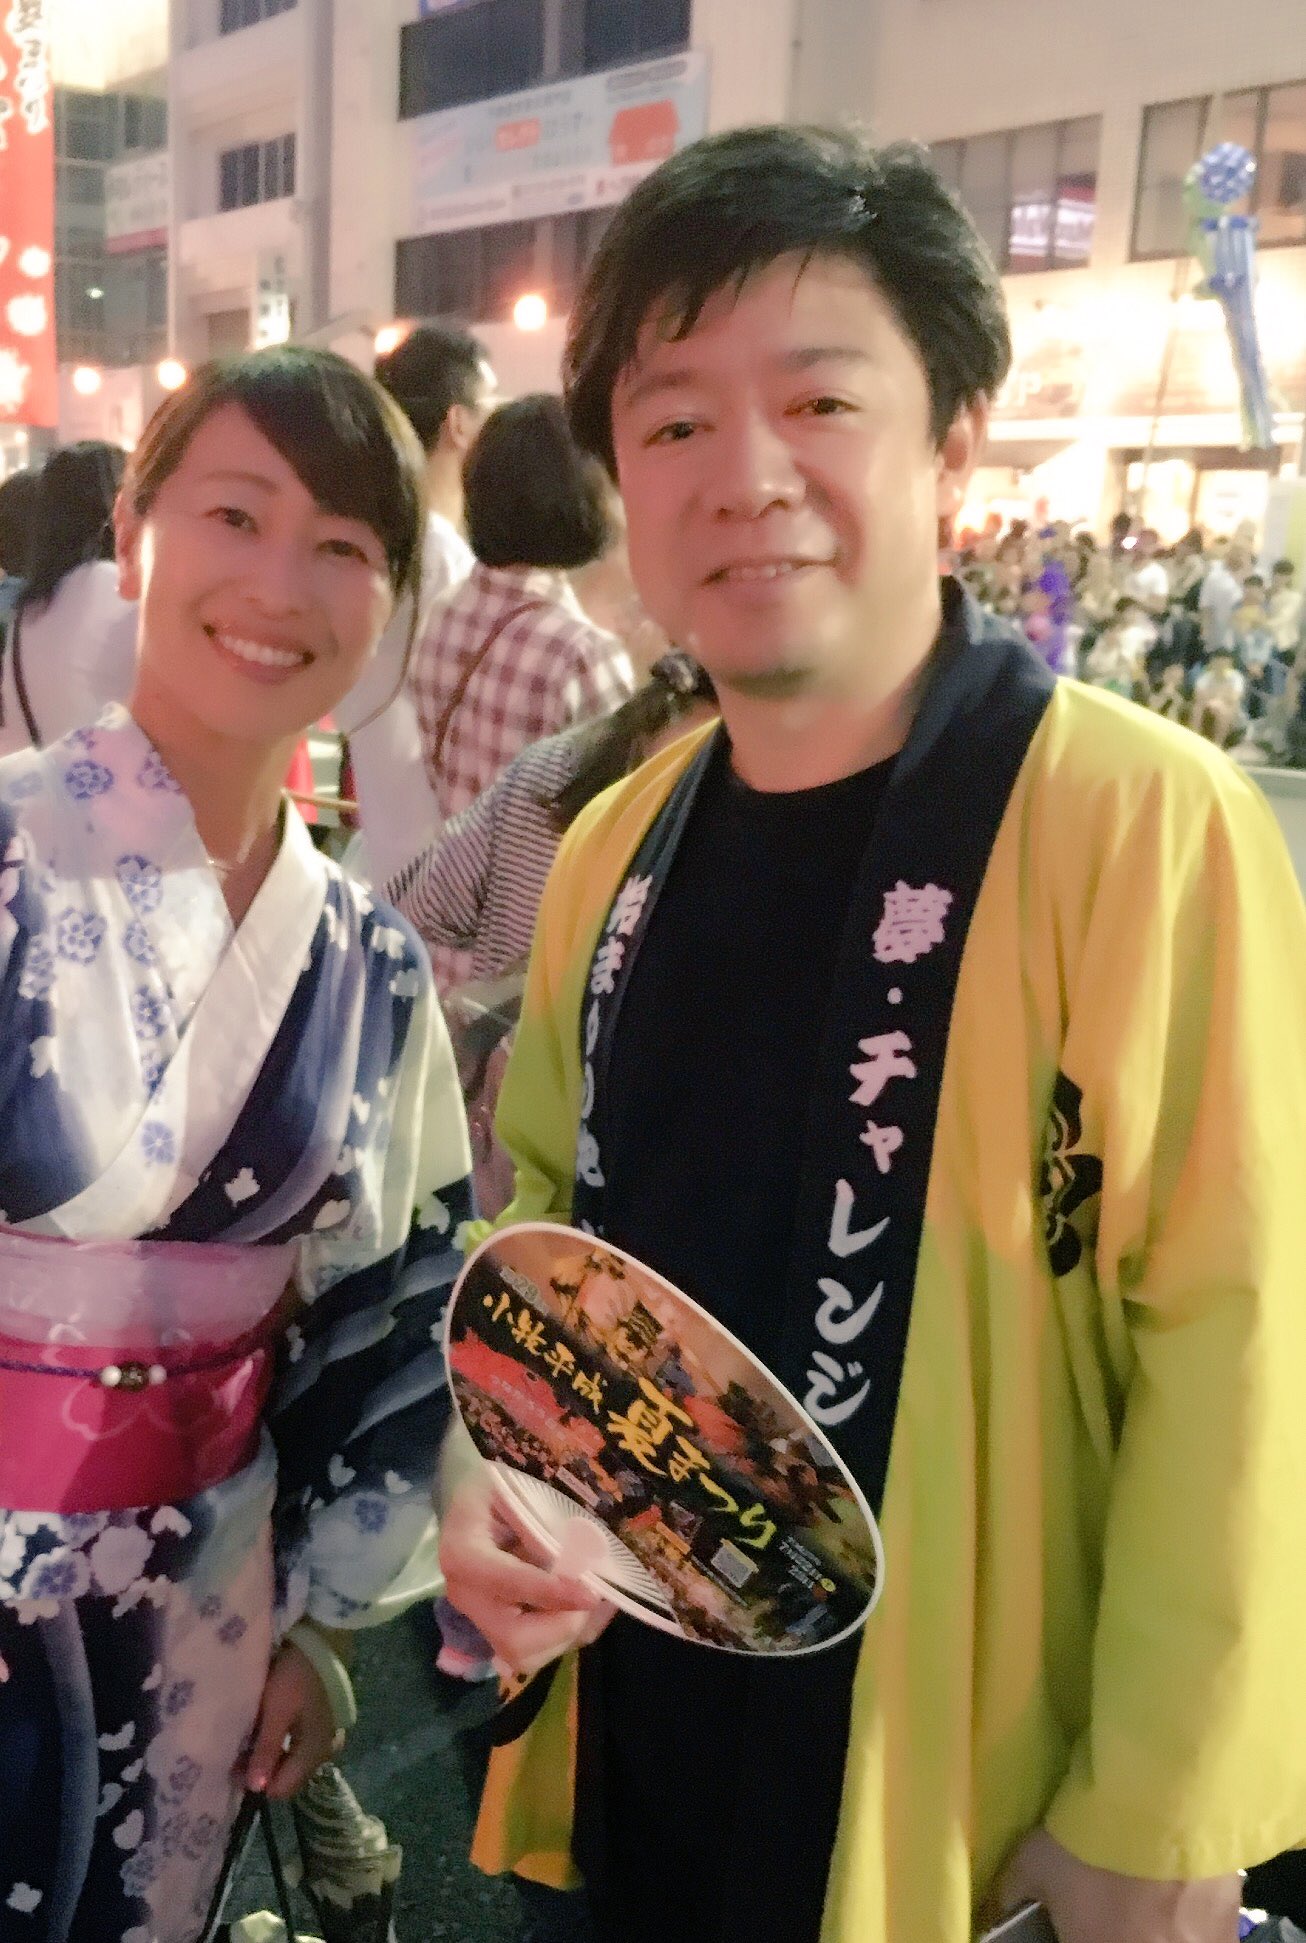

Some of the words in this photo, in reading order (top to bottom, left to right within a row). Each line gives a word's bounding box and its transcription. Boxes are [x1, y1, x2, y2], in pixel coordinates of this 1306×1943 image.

[803, 878, 953, 1427] 夢・チャレンジ
